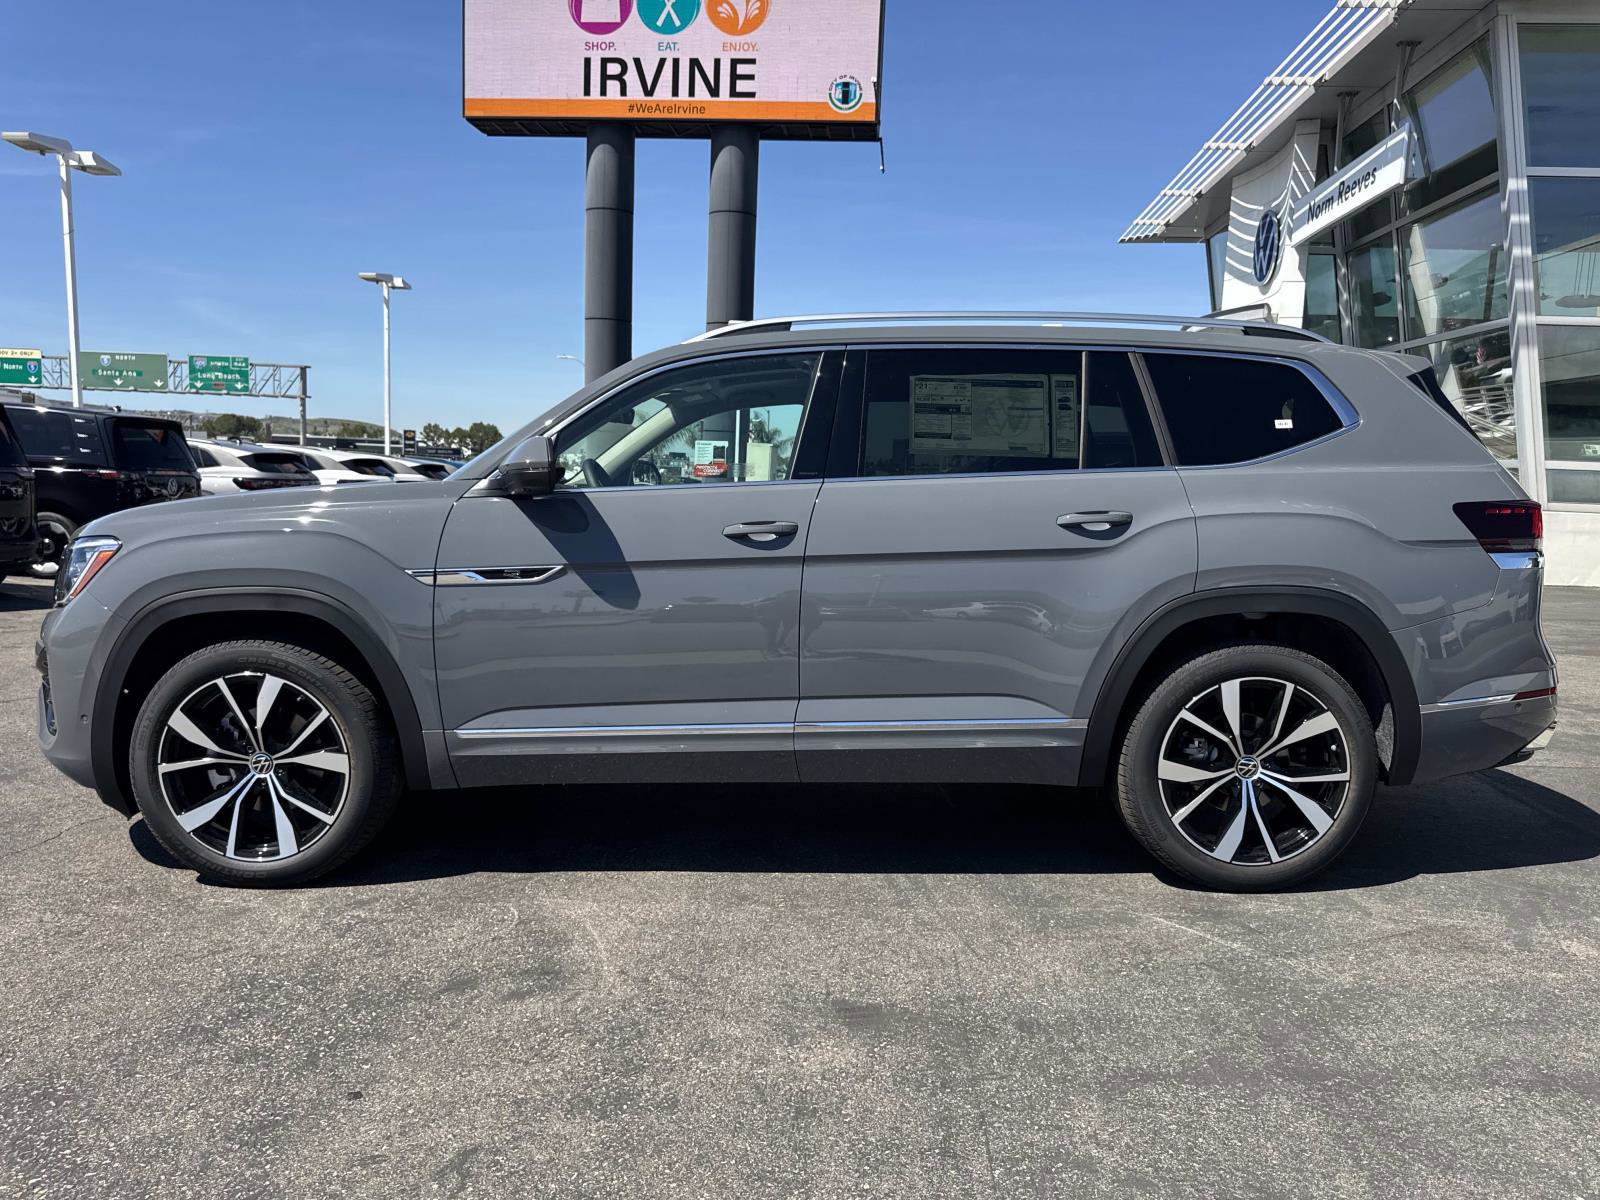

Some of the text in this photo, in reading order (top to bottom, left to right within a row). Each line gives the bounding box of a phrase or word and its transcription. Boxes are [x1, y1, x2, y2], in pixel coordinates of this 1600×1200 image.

[584, 41, 617, 51] SHOP.
[657, 42, 680, 52] EAT.
[722, 42, 759, 52] ENJOY.
[583, 57, 757, 98] IRVINE
[628, 103, 706, 115] #WeAreIrvine
[1306, 165, 1377, 224] Norm Reeves
